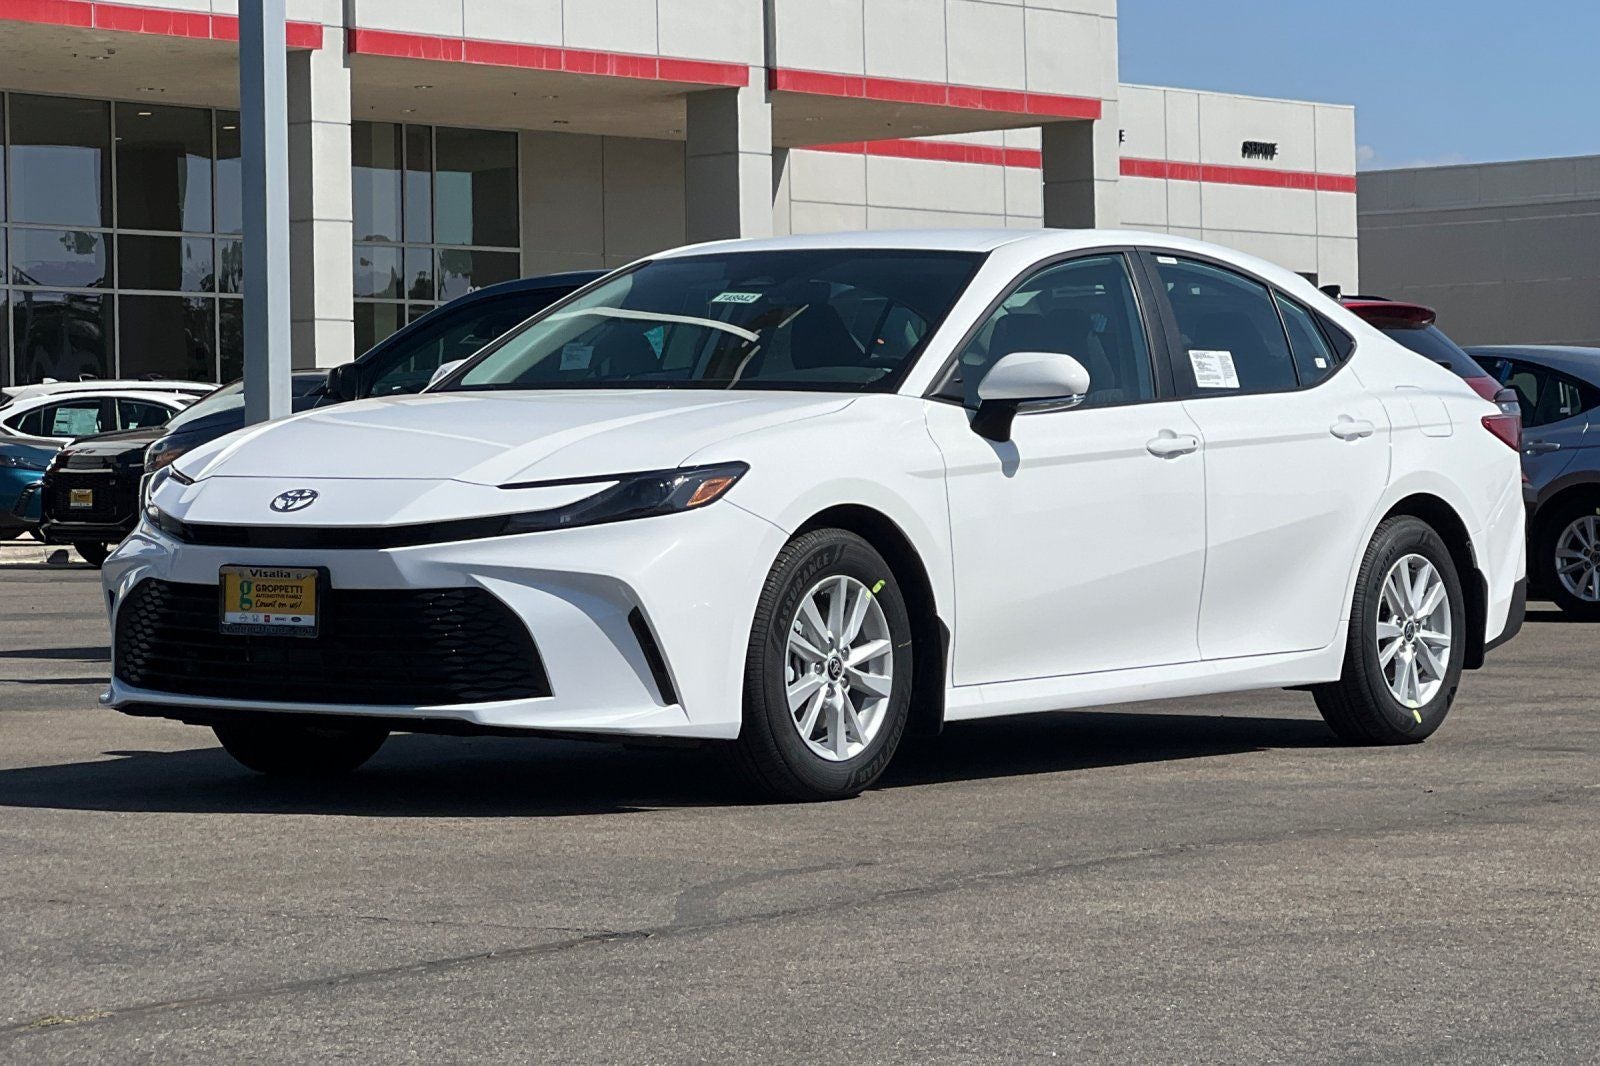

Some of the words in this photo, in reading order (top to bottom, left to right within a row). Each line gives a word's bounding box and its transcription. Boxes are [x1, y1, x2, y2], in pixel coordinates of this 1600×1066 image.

[250, 569, 291, 578] Visalia
[255, 584, 303, 594] GROPPETTI
[779, 552, 831, 631] ASSURANCE
[255, 599, 277, 608] Count
